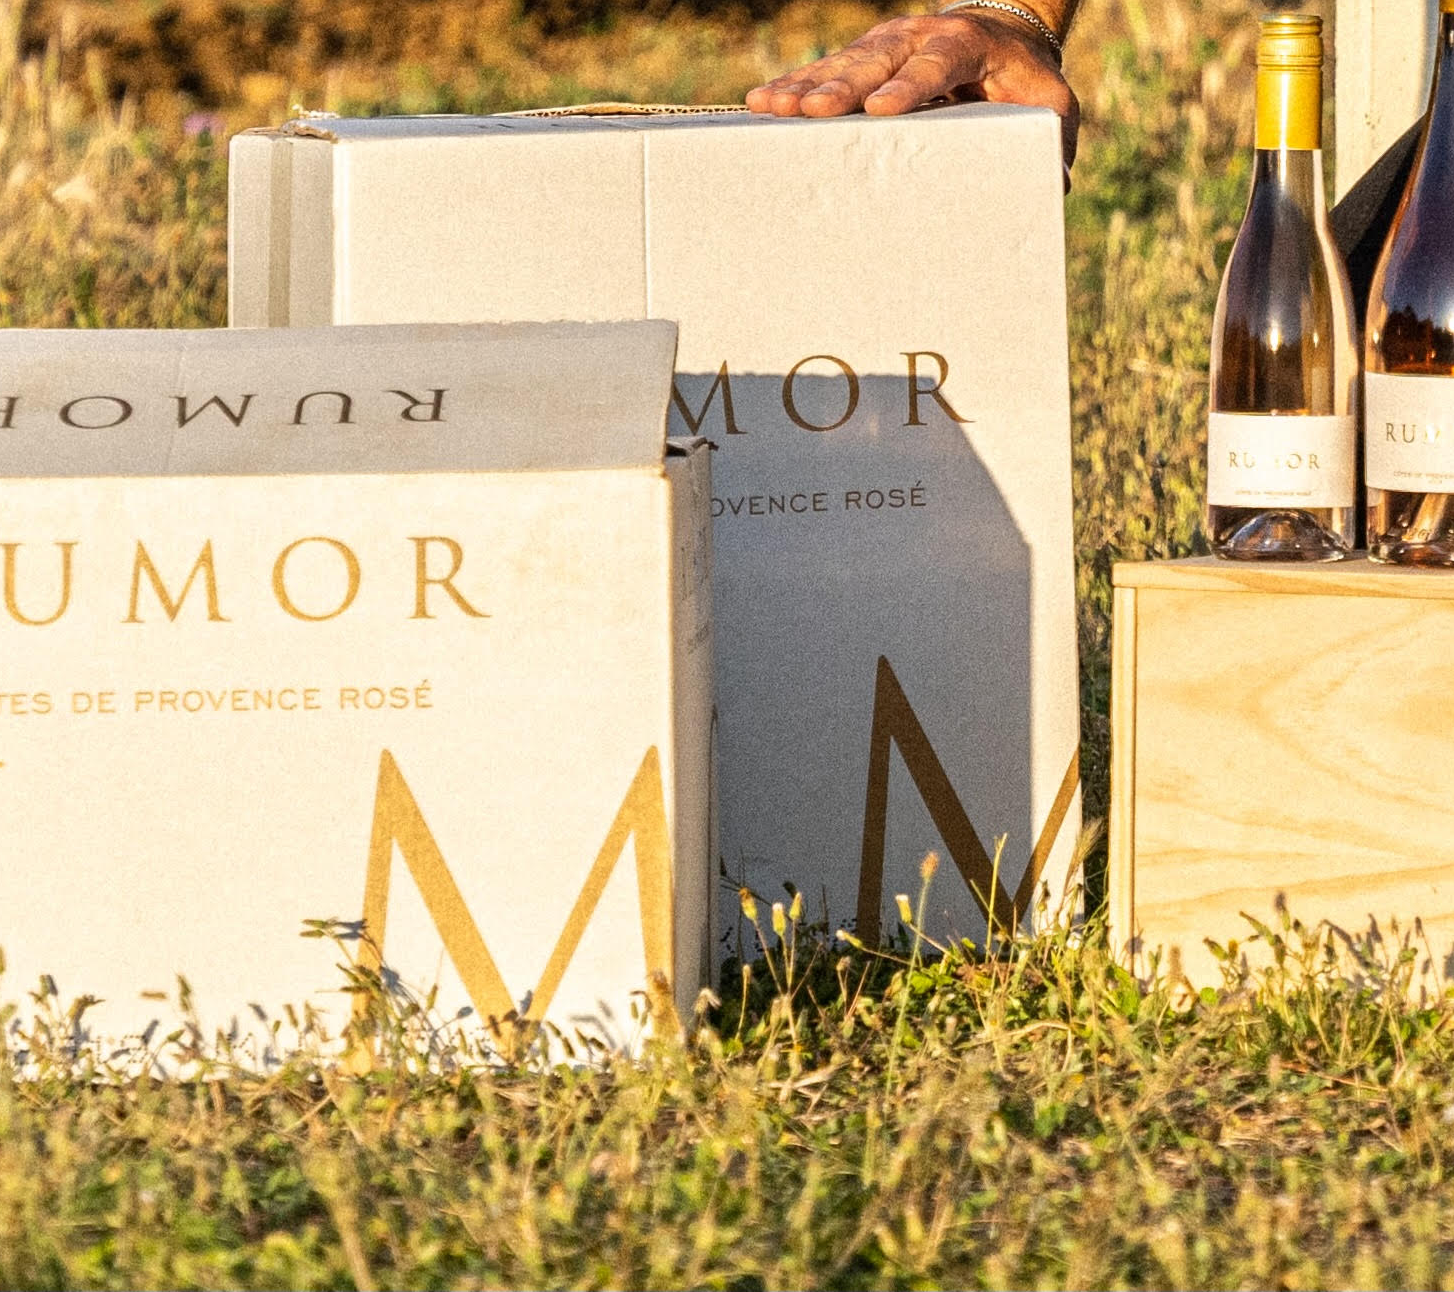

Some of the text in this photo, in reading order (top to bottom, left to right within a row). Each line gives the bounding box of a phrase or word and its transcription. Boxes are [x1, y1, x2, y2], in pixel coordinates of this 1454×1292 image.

[1227, 450, 1322, 471] RUOR
[844, 480, 927, 511] ROSÉ
[70, 689, 117, 716] DE
[133, 686, 323, 715] PROVENCE
[337, 677, 435, 712] ROSÉ
